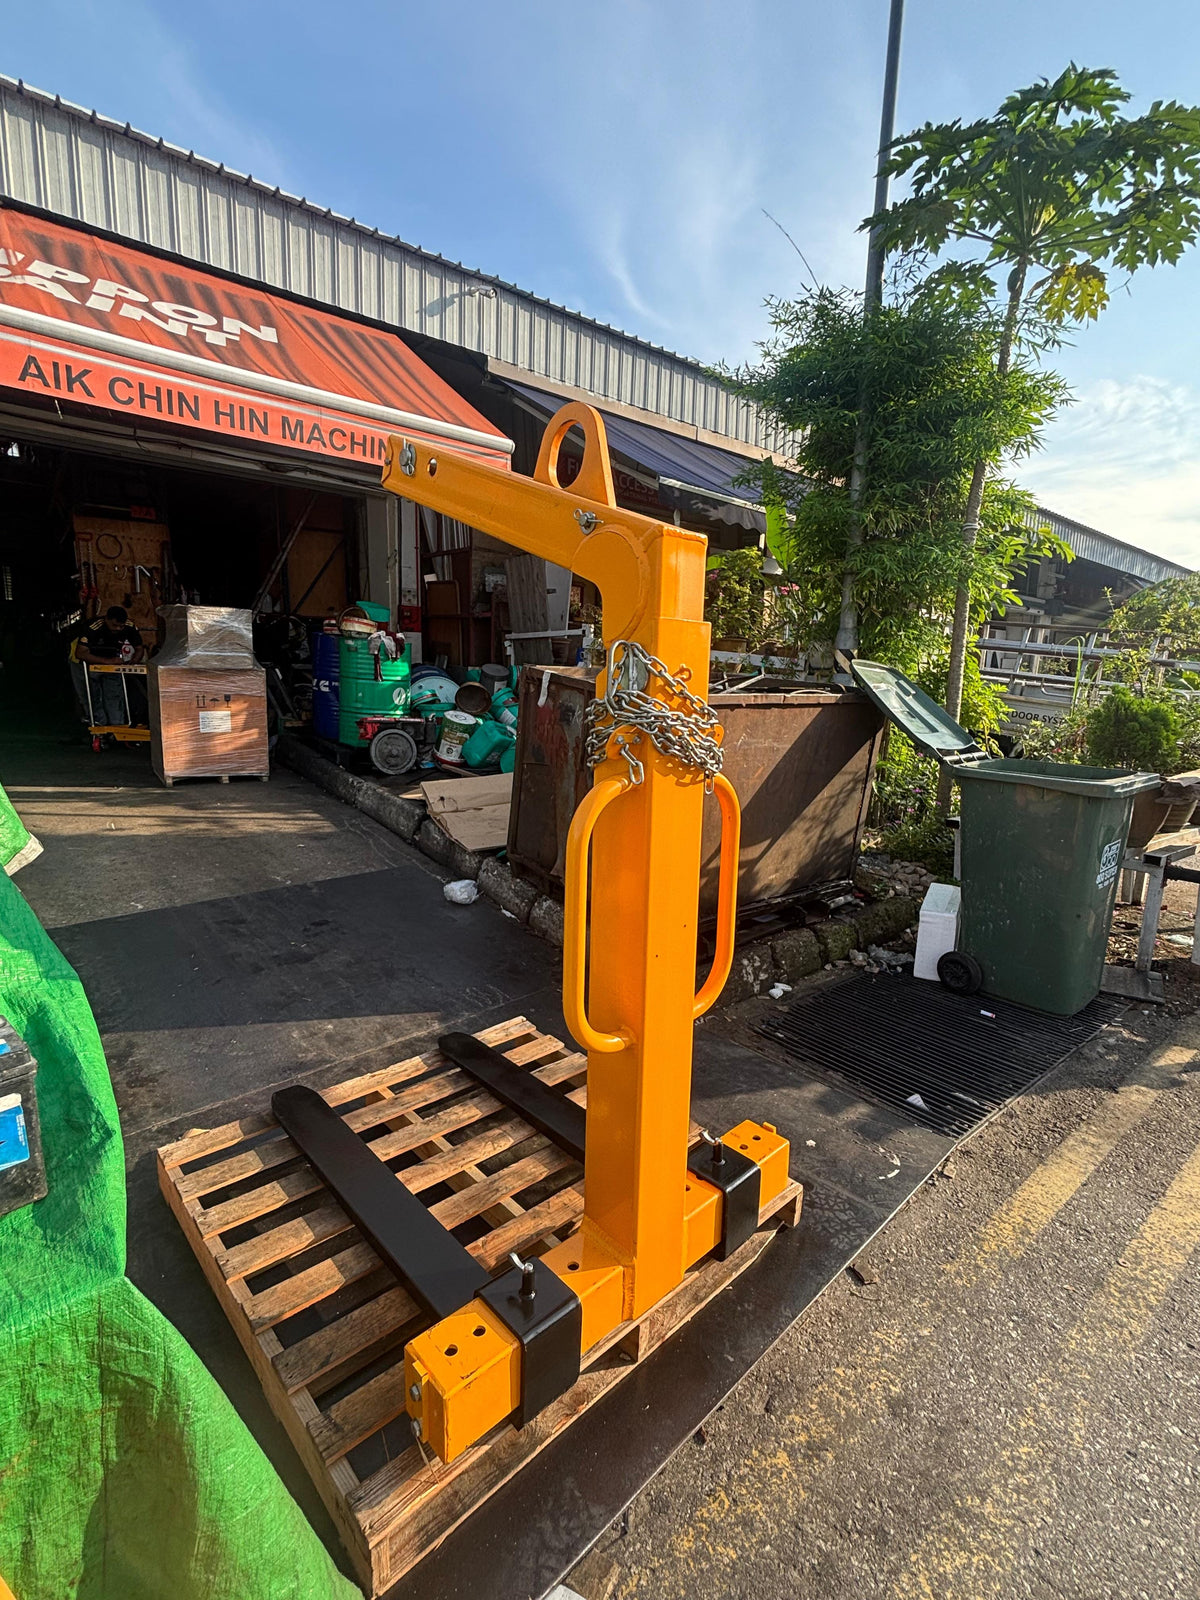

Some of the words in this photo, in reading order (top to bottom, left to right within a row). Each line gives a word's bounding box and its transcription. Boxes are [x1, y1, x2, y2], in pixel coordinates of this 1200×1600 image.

[18, 354, 96, 399] AIK
[108, 376, 200, 422] CHIN
[213, 399, 270, 436] HIN
[1011, 710, 1040, 722] DOOR
